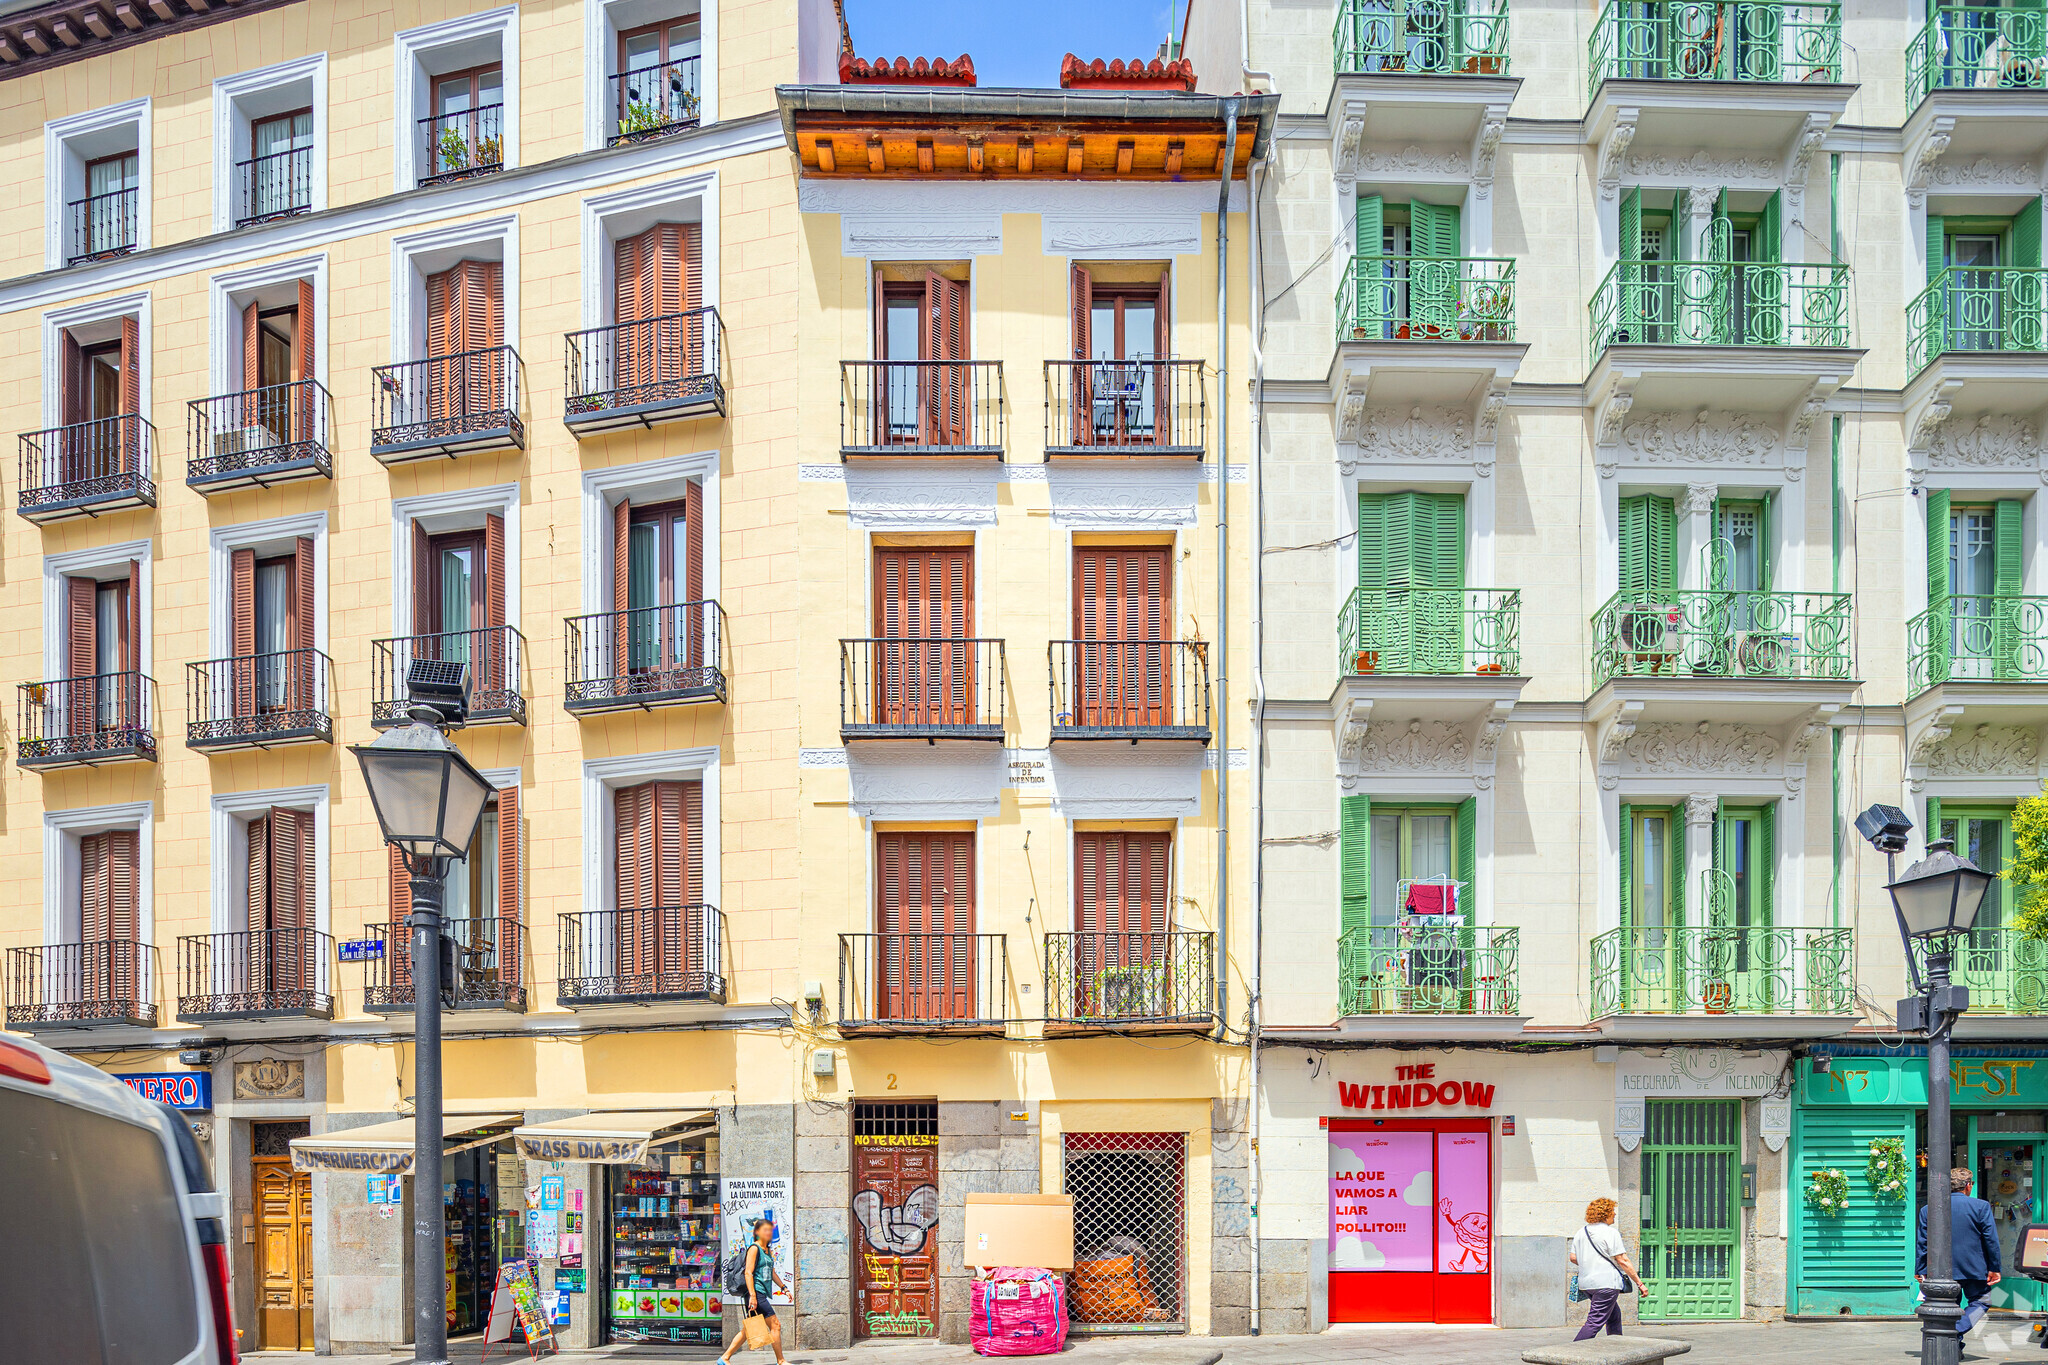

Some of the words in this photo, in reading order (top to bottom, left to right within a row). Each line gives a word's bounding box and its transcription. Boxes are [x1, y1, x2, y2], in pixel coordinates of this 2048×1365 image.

[349, 941, 375, 950] PLAZA
[341, 951, 352, 960] SAN
[353, 949, 382, 959] ILDEONO
[1709, 1054, 1718, 1069] 3
[1395, 1063, 1436, 1081] THE
[886, 1073, 898, 1090] 2
[1623, 1074, 1682, 1090] ASEGURADA
[1338, 1080, 1496, 1110] WINDOW
[854, 1135, 870, 1146] NO
[871, 1135, 887, 1146] TE
[523, 1139, 571, 1158] SPASS
[577, 1141, 606, 1159] DIA
[611, 1142, 640, 1160] 365
[295, 1151, 414, 1170] SUPERMERCADO
[1335, 1171, 1354, 1181] LA
[1356, 1171, 1386, 1183] QUE
[624, 1184, 644, 1195] Red
[645, 1184, 665, 1195] Bull
[729, 1181, 746, 1189] PARA
[747, 1181, 765, 1189] VIVIR
[766, 1180, 786, 1189] HASTA
[730, 1191, 739, 1199] LA
[739, 1189, 762, 1199] ÚLTIMA
[763, 1190, 785, 1199] STORY.
[1335, 1188, 1386, 1198] VAMOS
[1387, 1188, 1398, 1198] A
[1335, 1206, 1369, 1216] LIAR
[1335, 1223, 1407, 1233] POLLITO!!!
